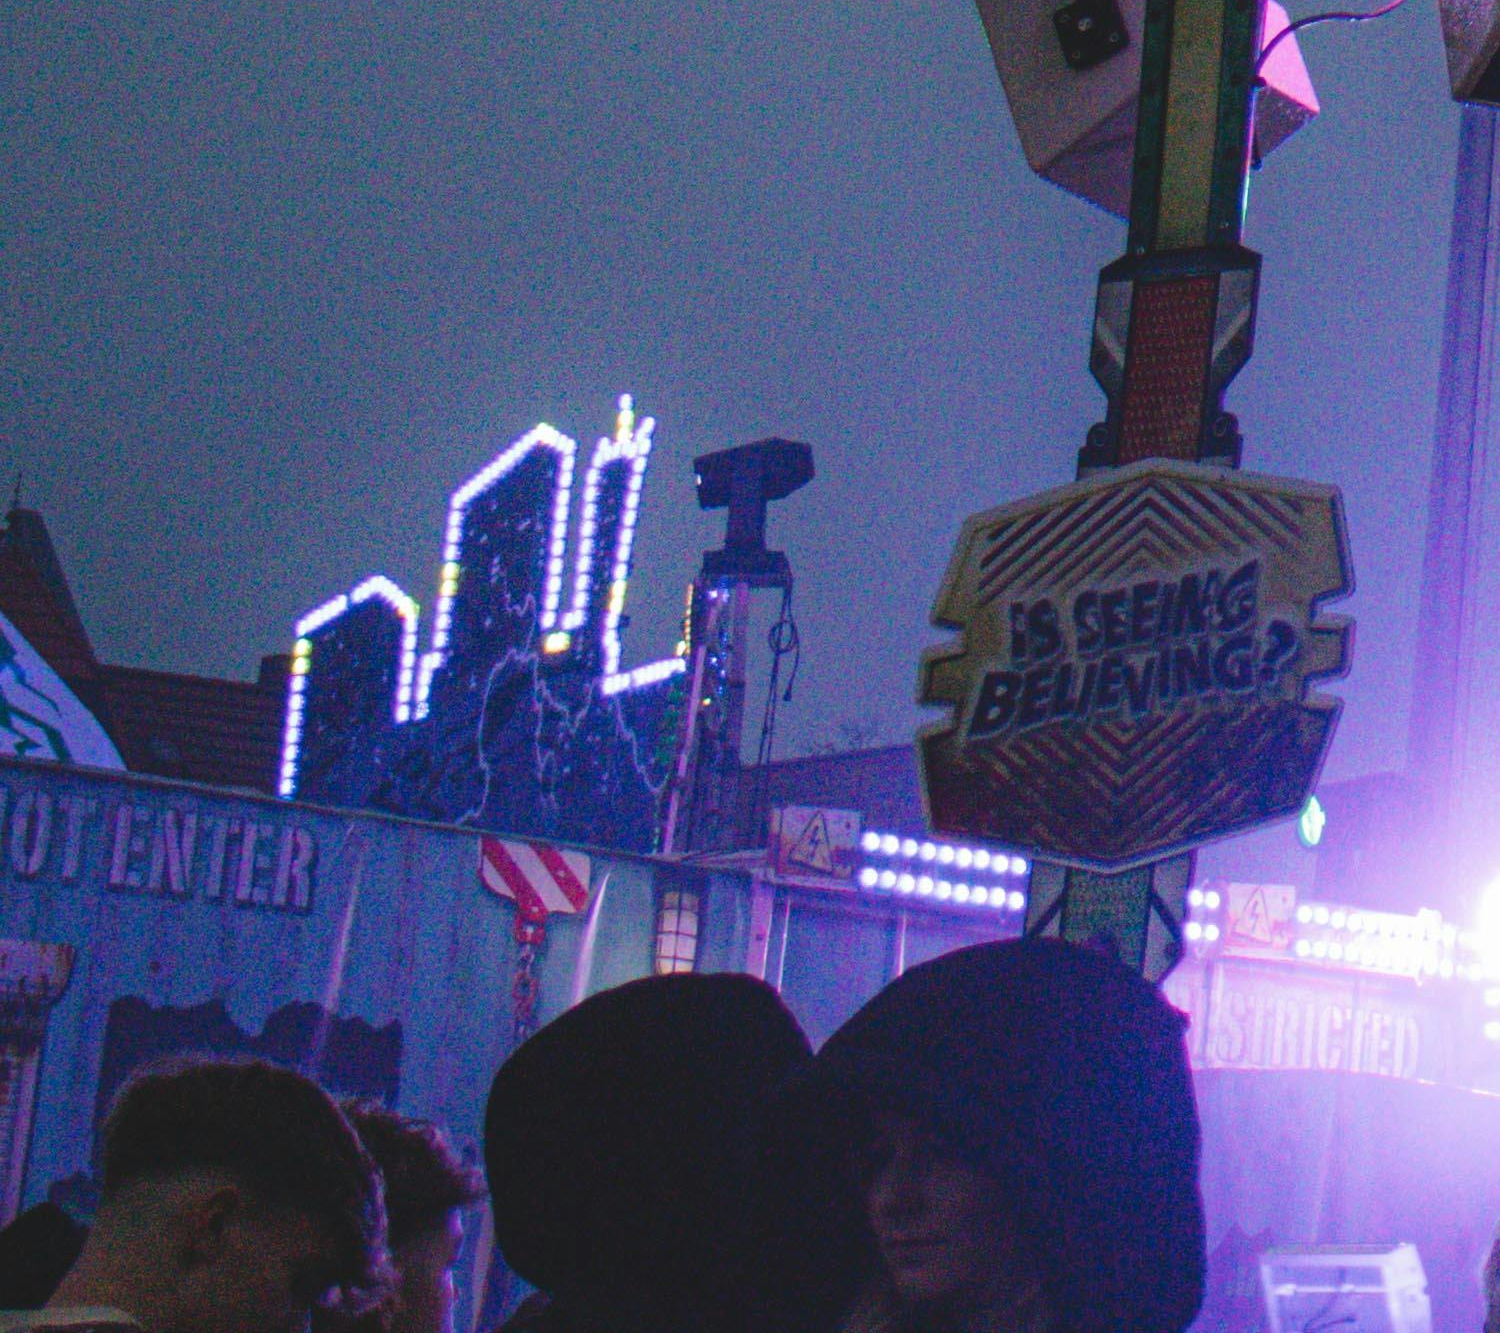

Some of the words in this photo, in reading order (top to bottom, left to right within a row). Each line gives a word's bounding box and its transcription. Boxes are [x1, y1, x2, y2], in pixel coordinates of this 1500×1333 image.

[1009, 597, 1061, 658] IS
[1073, 559, 1259, 653] SEEING
[970, 619, 1299, 732] BELIEVING?
[0, 786, 98, 880] OT
[108, 803, 316, 909] ENTER
